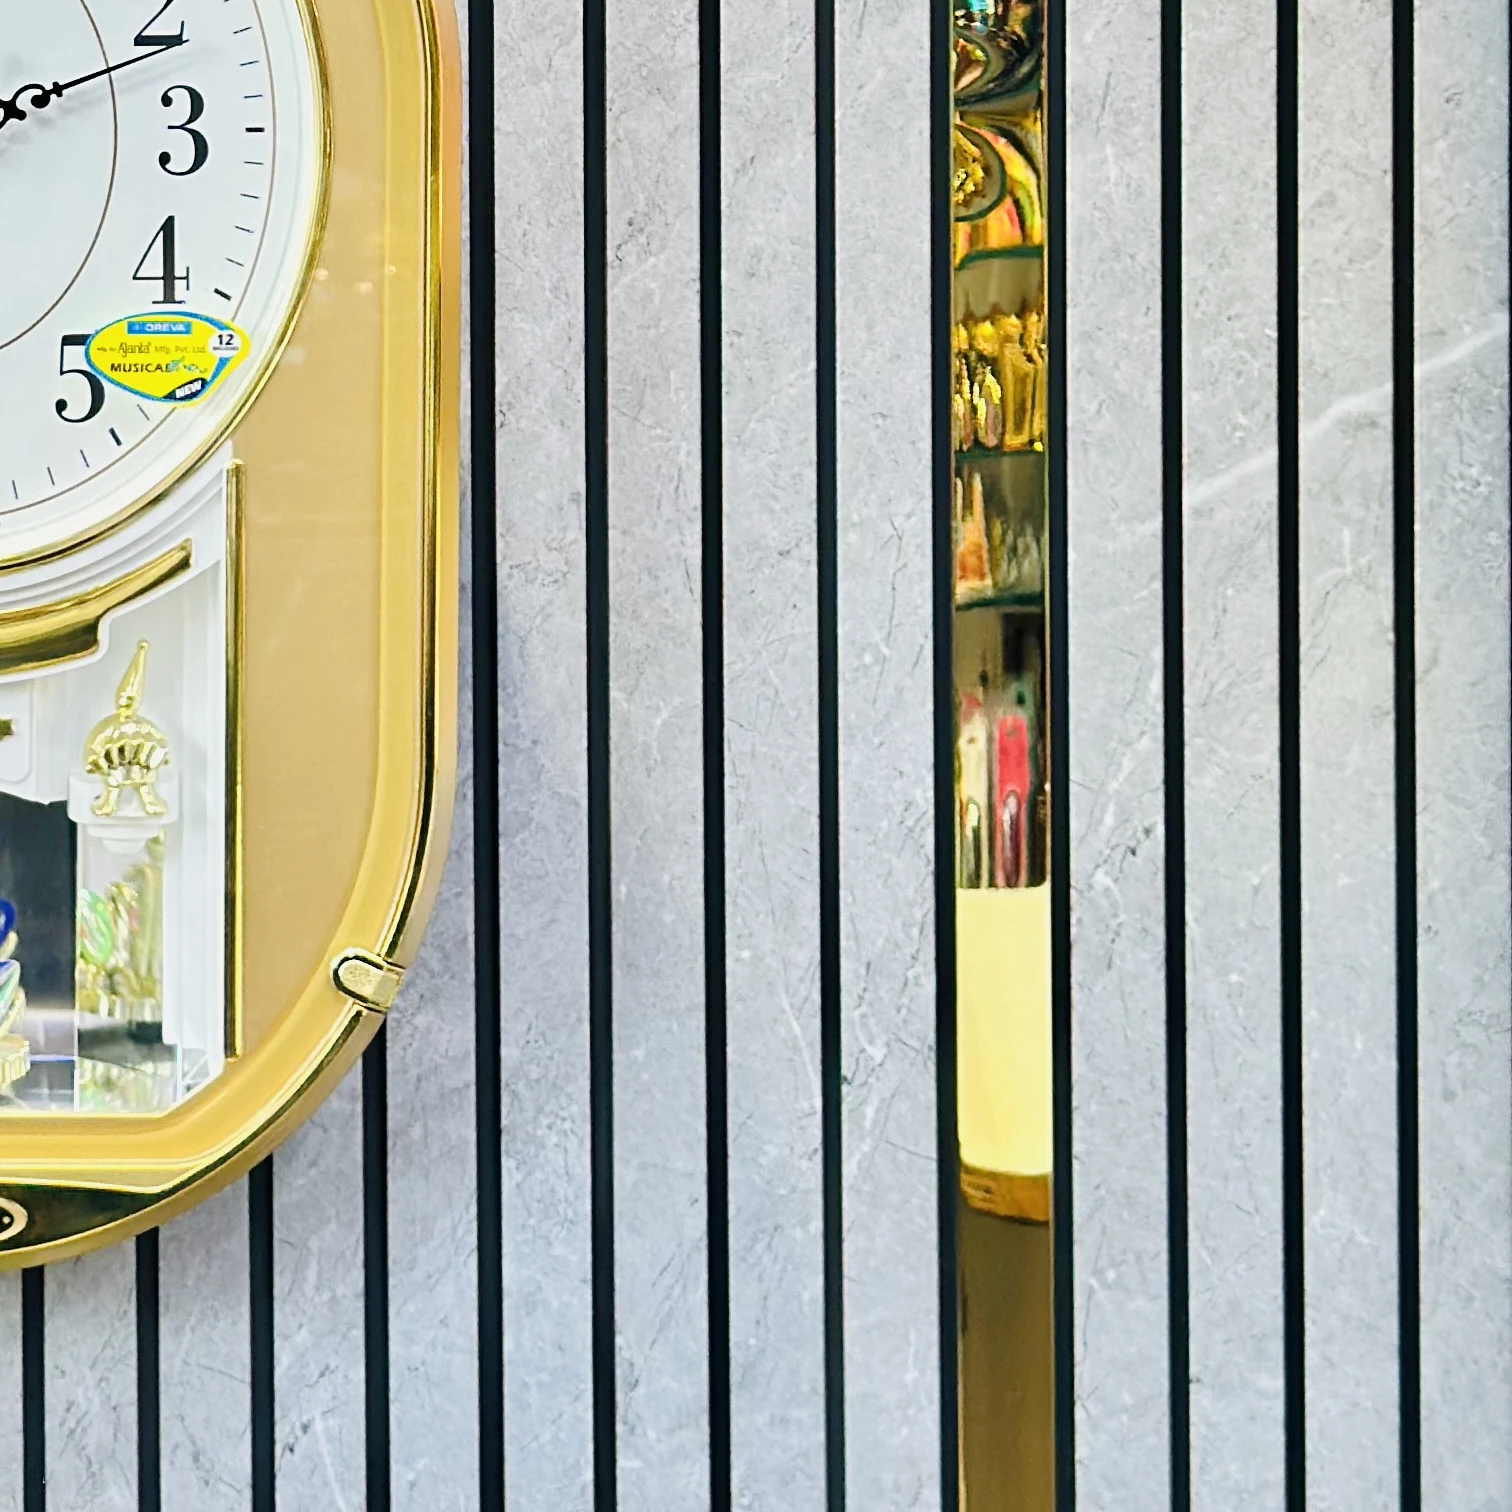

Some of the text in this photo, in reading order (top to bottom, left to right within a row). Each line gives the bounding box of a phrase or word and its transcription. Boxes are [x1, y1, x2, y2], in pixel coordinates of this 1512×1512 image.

[159, 85, 209, 177] 3
[133, 216, 190, 305] 4
[56, 334, 106, 424] 5
[217, 333, 235, 346] 12
[175, 379, 203, 400] NEW
